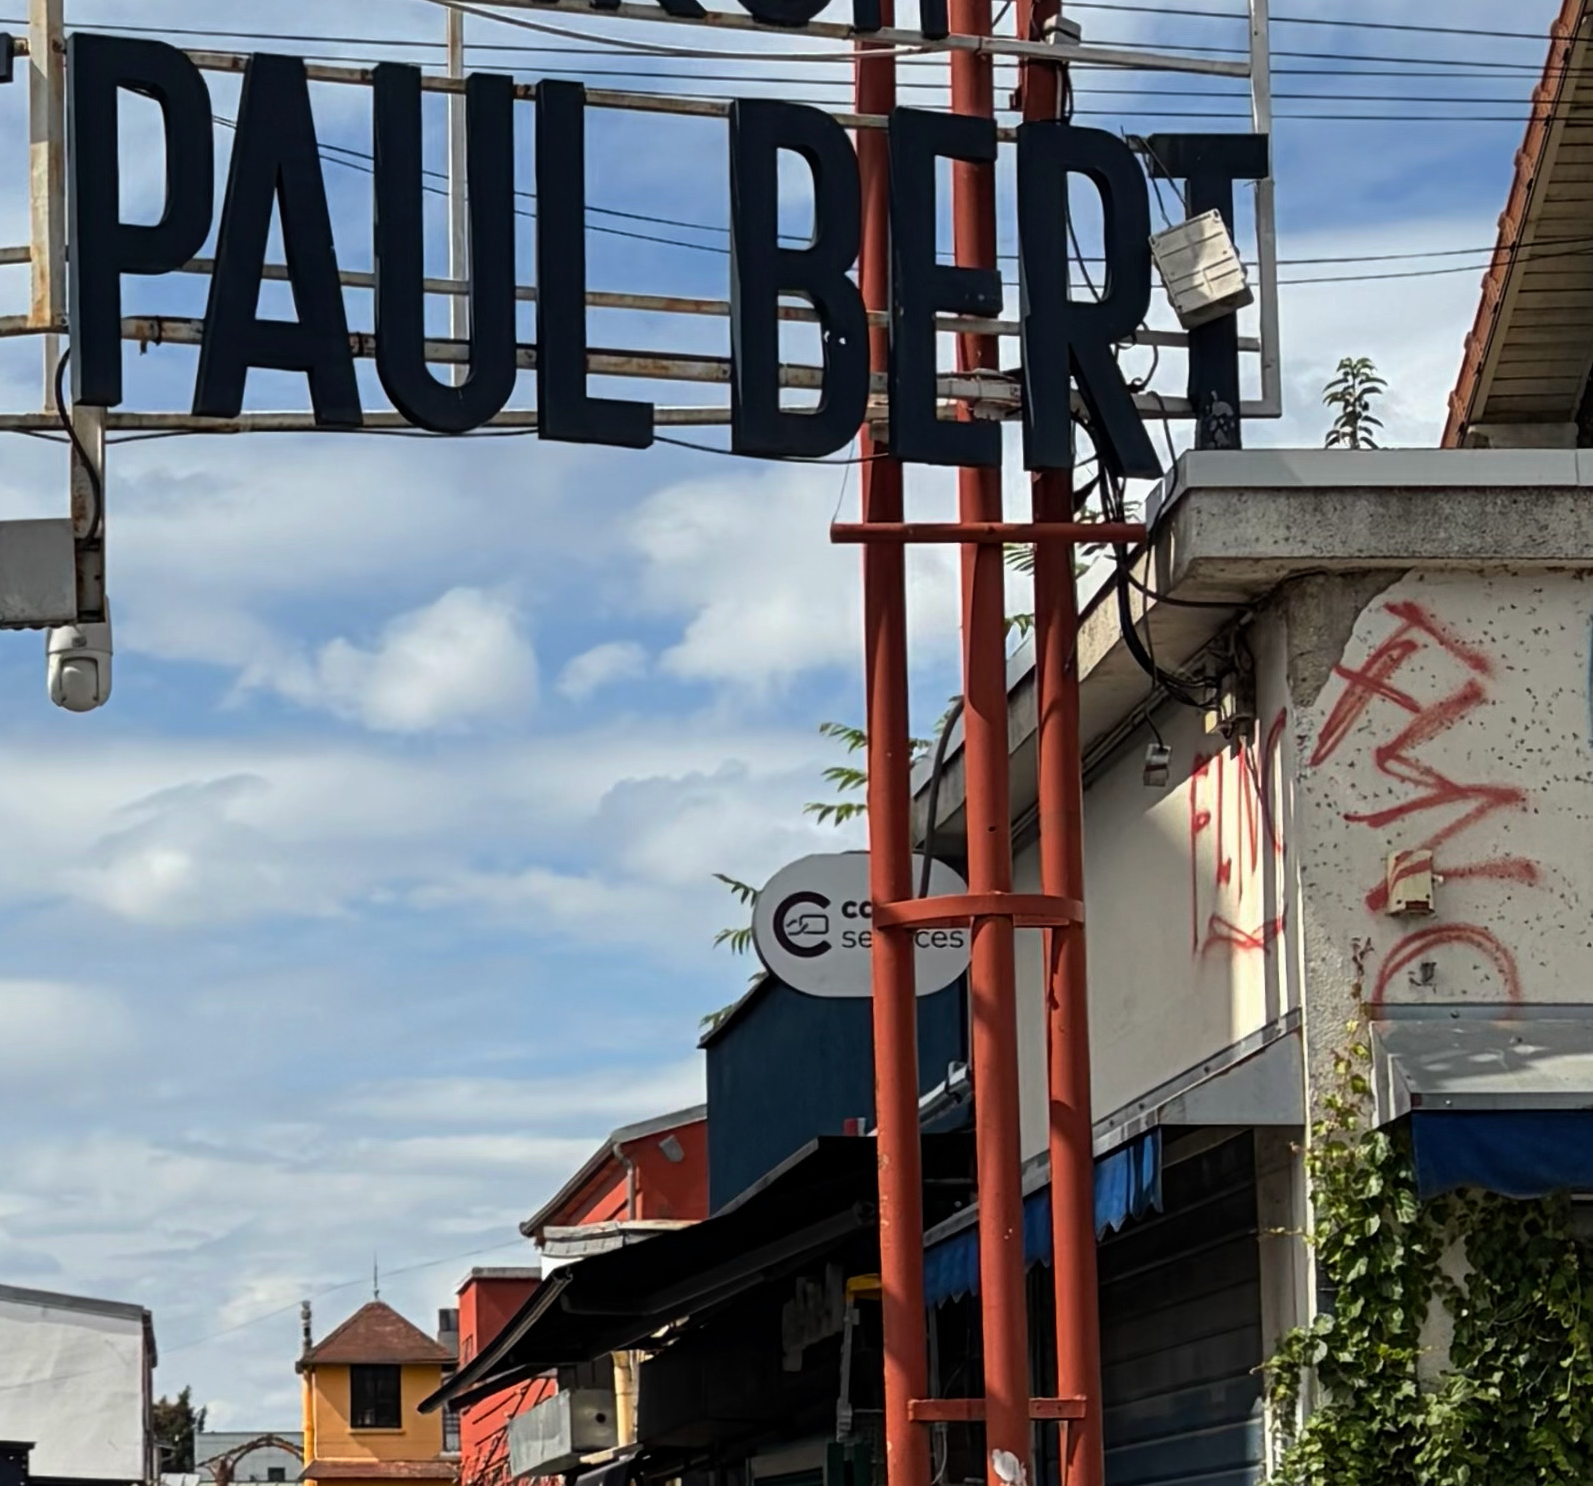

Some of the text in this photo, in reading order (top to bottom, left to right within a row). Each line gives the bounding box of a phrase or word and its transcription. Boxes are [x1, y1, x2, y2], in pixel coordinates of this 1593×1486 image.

[69, 33, 1269, 481] PAUL BERT
[841, 930, 965, 949] seces
